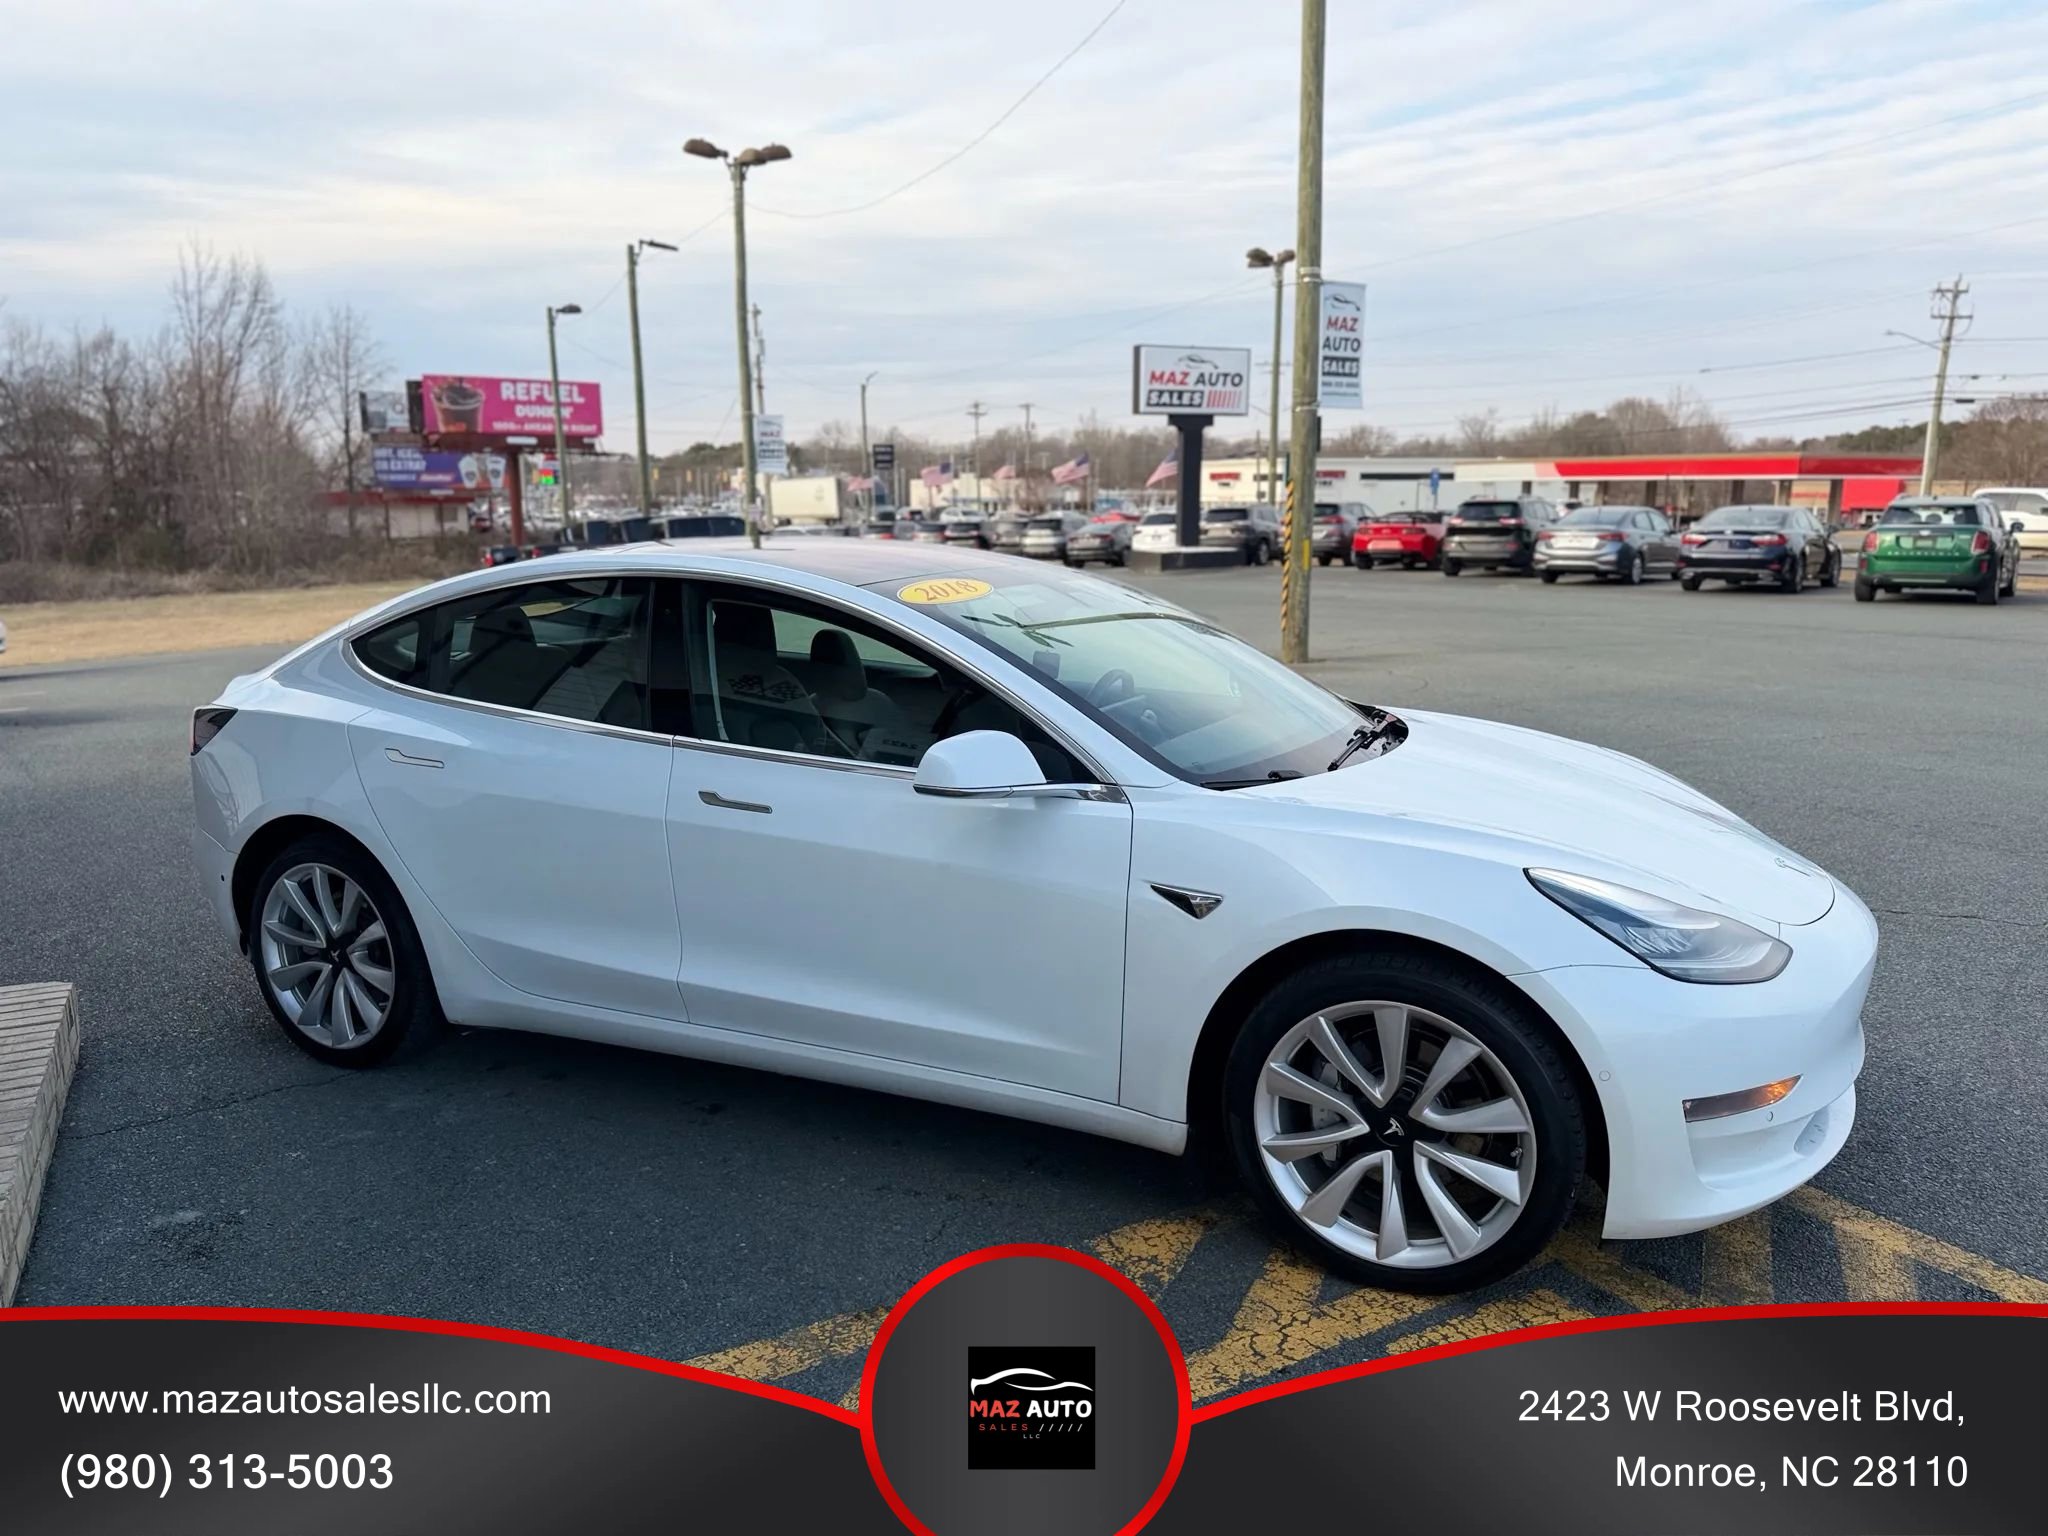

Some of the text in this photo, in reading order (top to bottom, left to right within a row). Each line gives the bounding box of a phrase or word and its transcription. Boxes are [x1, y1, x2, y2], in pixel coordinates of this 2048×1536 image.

[1327, 316, 1359, 332] MAZ
[1323, 337, 1361, 352] AUTO
[1323, 359, 1358, 374] SALES
[1149, 370, 1244, 387] MAZ AUTO
[501, 381, 585, 404] REFUEL
[1149, 390, 1202, 406] SALES
[914, 580, 978, 602] 2018
